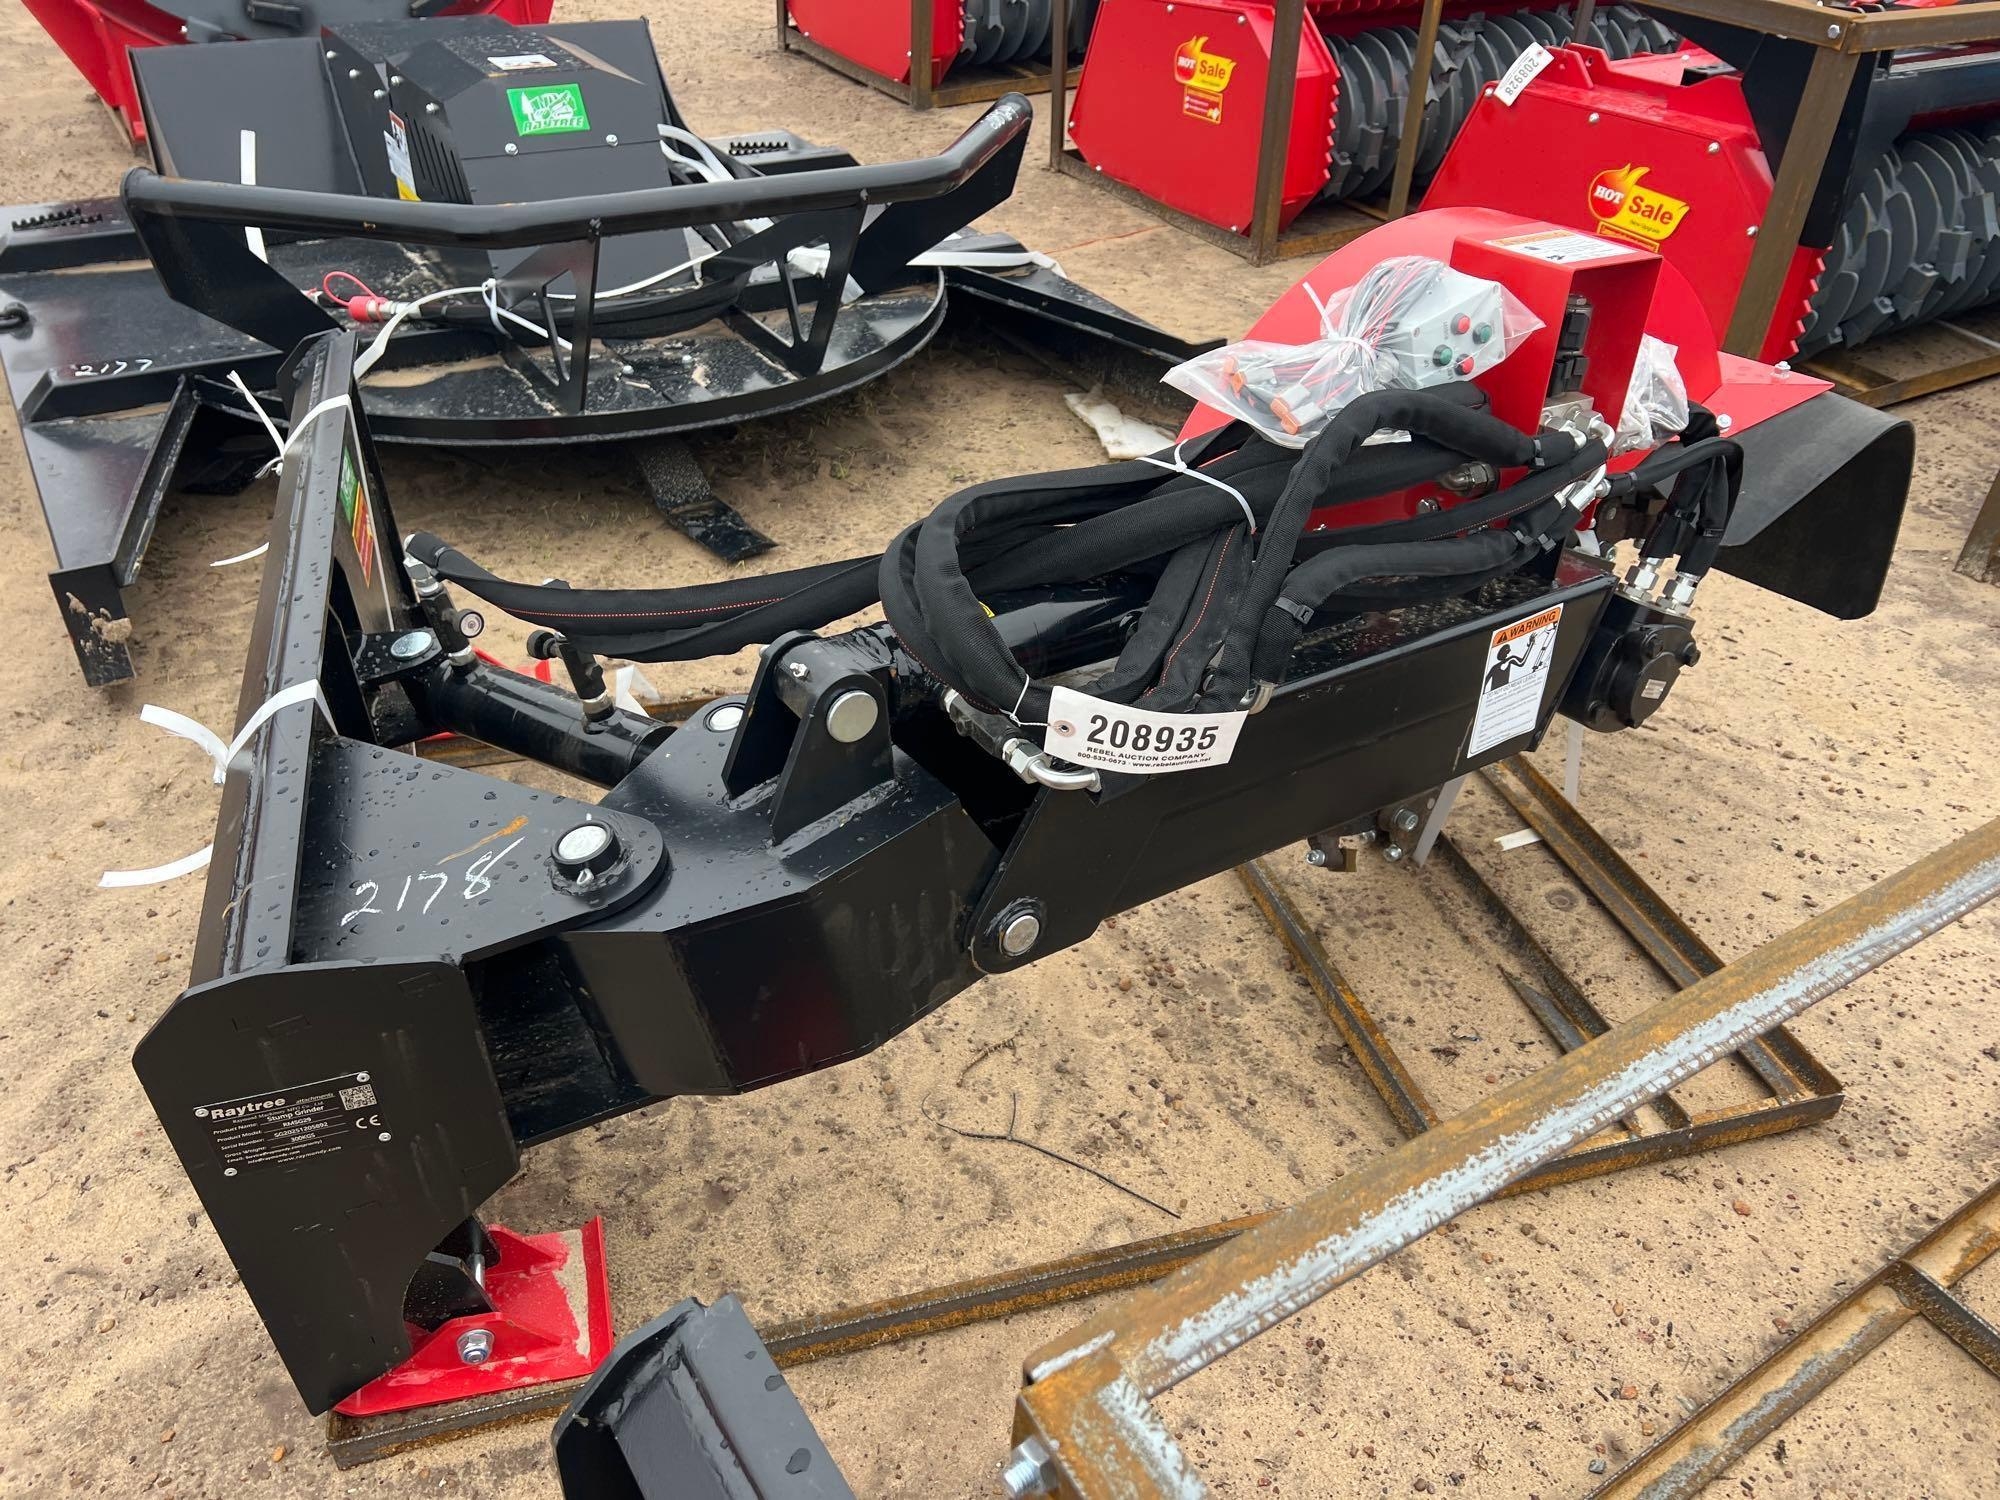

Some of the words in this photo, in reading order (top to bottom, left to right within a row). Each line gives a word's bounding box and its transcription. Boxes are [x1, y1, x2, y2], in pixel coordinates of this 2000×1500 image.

[1200, 60, 1226, 79] Sale
[1505, 57, 1539, 96] 208928
[1594, 185, 1625, 205] HOT
[1629, 195, 1673, 225] Sale
[74, 358, 153, 377] 2177
[1510, 611, 1556, 636] WARNING
[1087, 714, 1219, 753] 208935
[1077, 752, 1126, 766] 800-533-0673
[1132, 757, 1211, 768] www.rebelauction.net
[1087, 746, 1114, 757] REBEL
[1119, 753, 1158, 762] AUCTION
[1161, 752, 1206, 762] COMPANY
[341, 836, 525, 927] 2178
[210, 1098, 287, 1120] Raytree
[213, 1125, 237, 1135] Product
[238, 1122, 258, 1131] Name:
[266, 1112, 293, 1122] Stump
[294, 1105, 325, 1117] Grinder
[217, 1133, 241, 1143] Product
[221, 1142, 238, 1151] Serial
[239, 1137, 265, 1148] Number:
[224, 1151, 241, 1159] Gross
